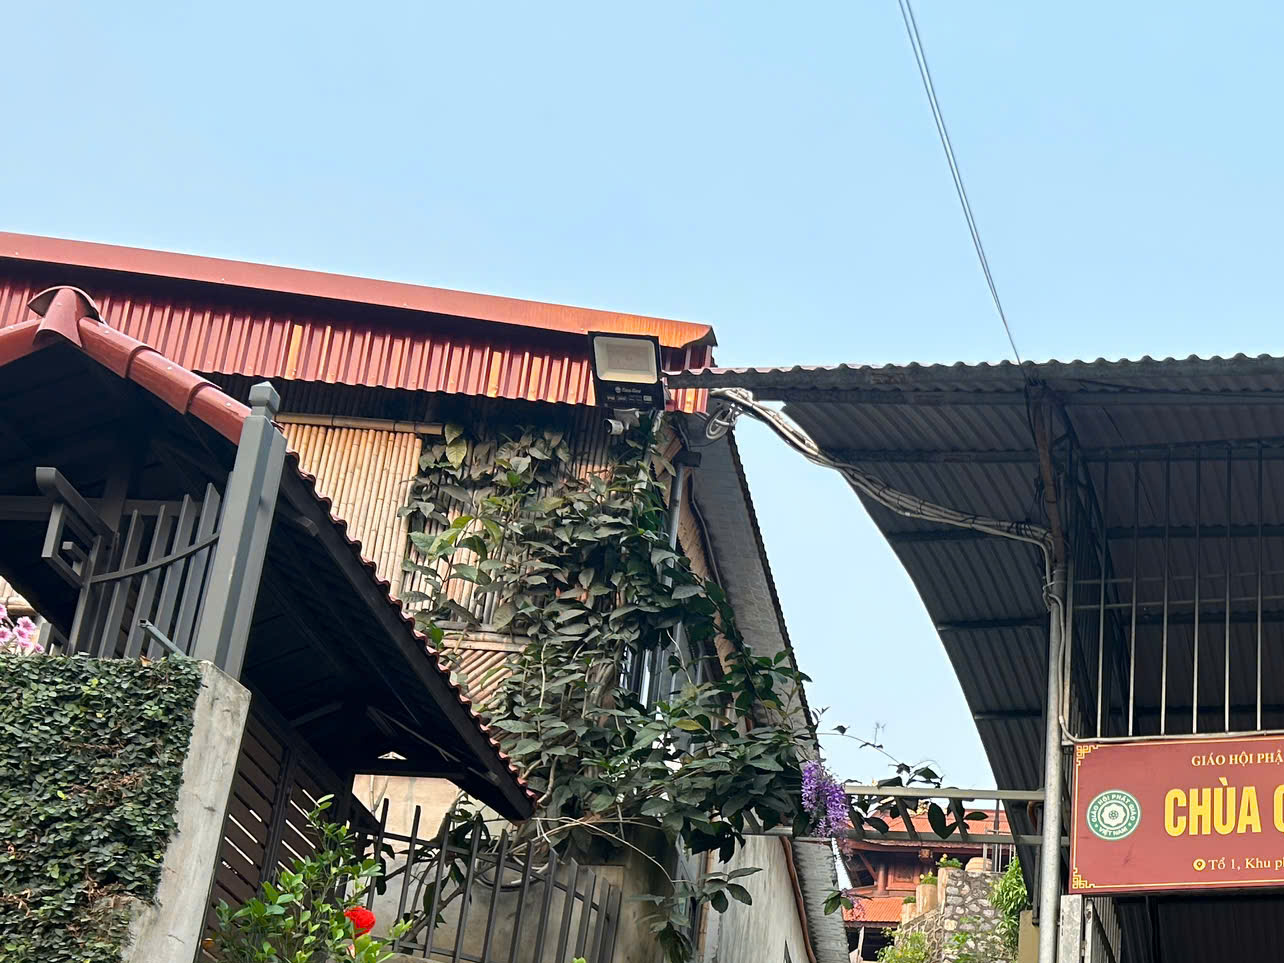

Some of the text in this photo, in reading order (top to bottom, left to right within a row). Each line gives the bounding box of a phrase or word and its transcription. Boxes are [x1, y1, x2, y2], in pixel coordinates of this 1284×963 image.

[1191, 752, 1225, 766] GIÁO
[1229, 751, 1253, 766] HỘI
[1164, 776, 1262, 837] CHÙA
[1208, 857, 1226, 870] Tổ
[1231, 859, 1241, 871] 1,
[1245, 858, 1271, 869] Khu
